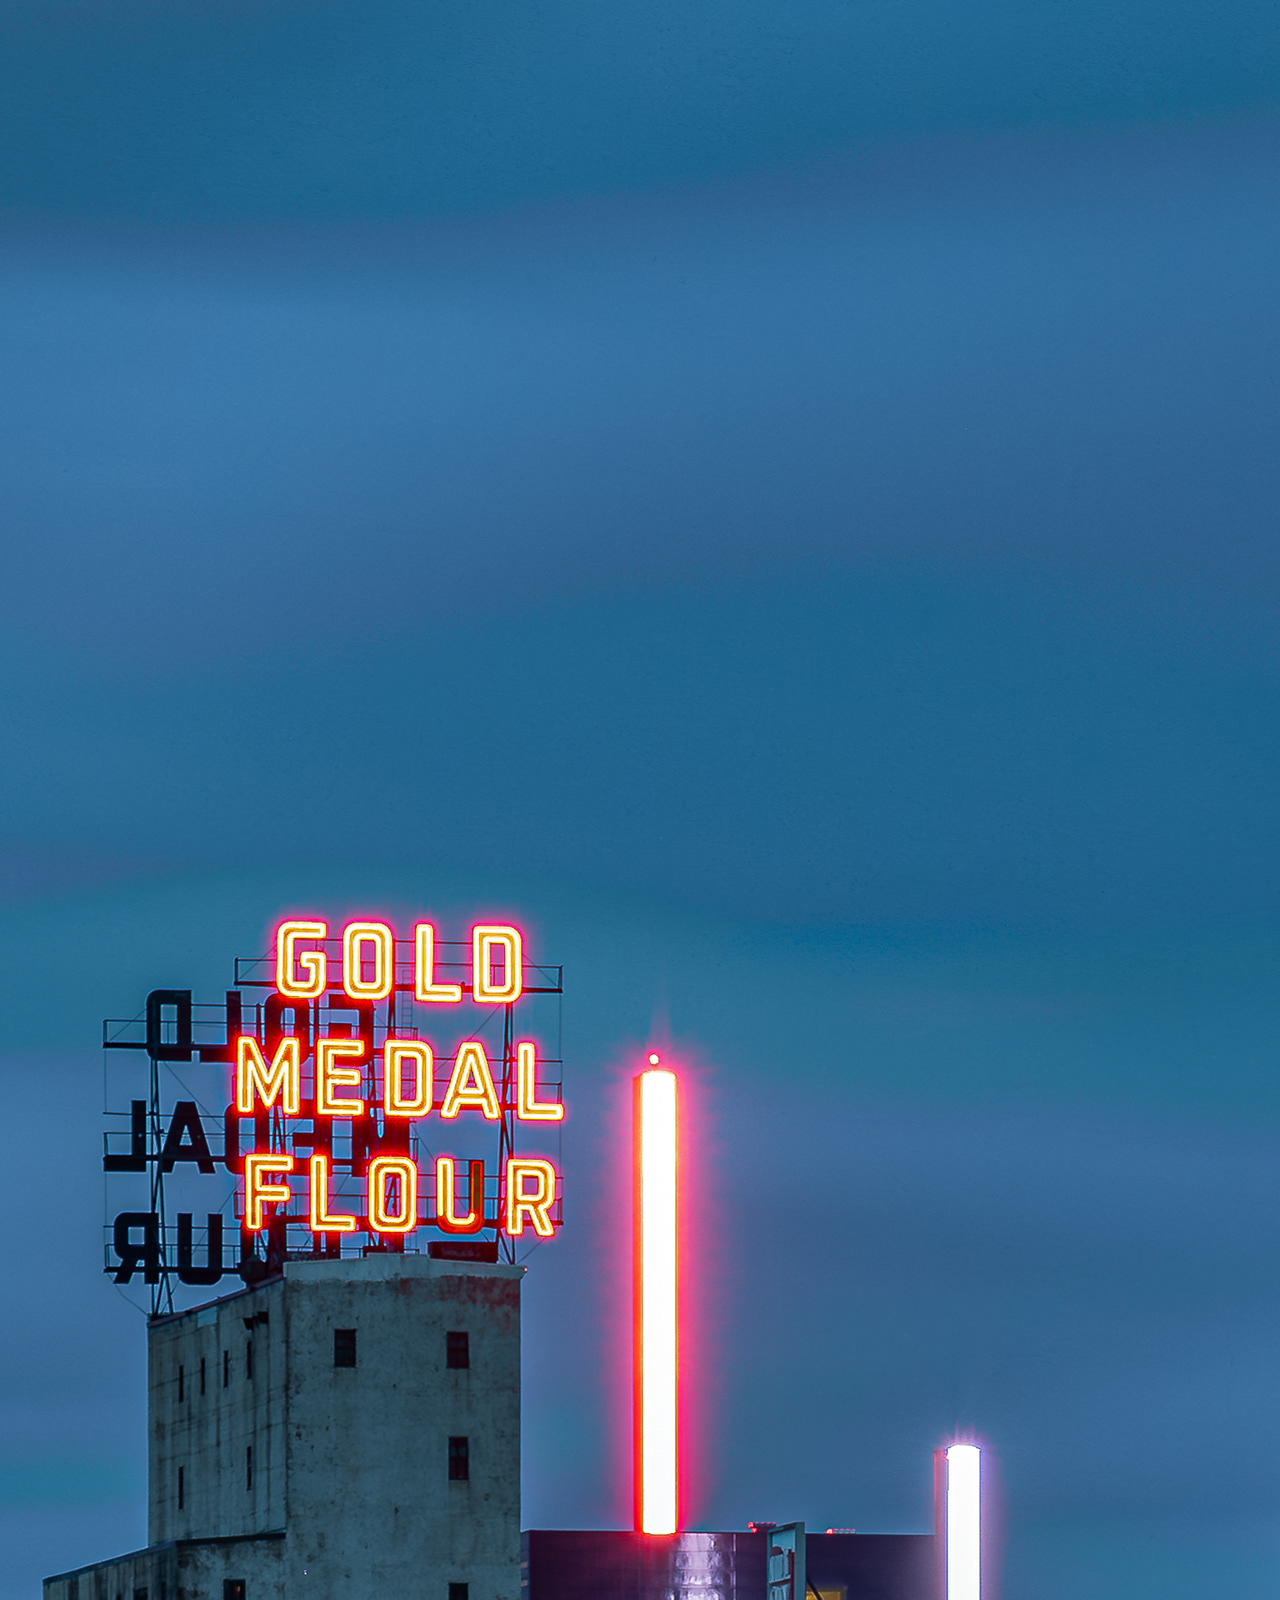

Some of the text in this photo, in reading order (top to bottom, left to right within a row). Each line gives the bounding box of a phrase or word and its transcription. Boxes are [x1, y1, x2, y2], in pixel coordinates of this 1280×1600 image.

[276, 921, 523, 1003] GOLD
[235, 1035, 564, 1121] MEDAL
[245, 1154, 556, 1237] FLOUR
